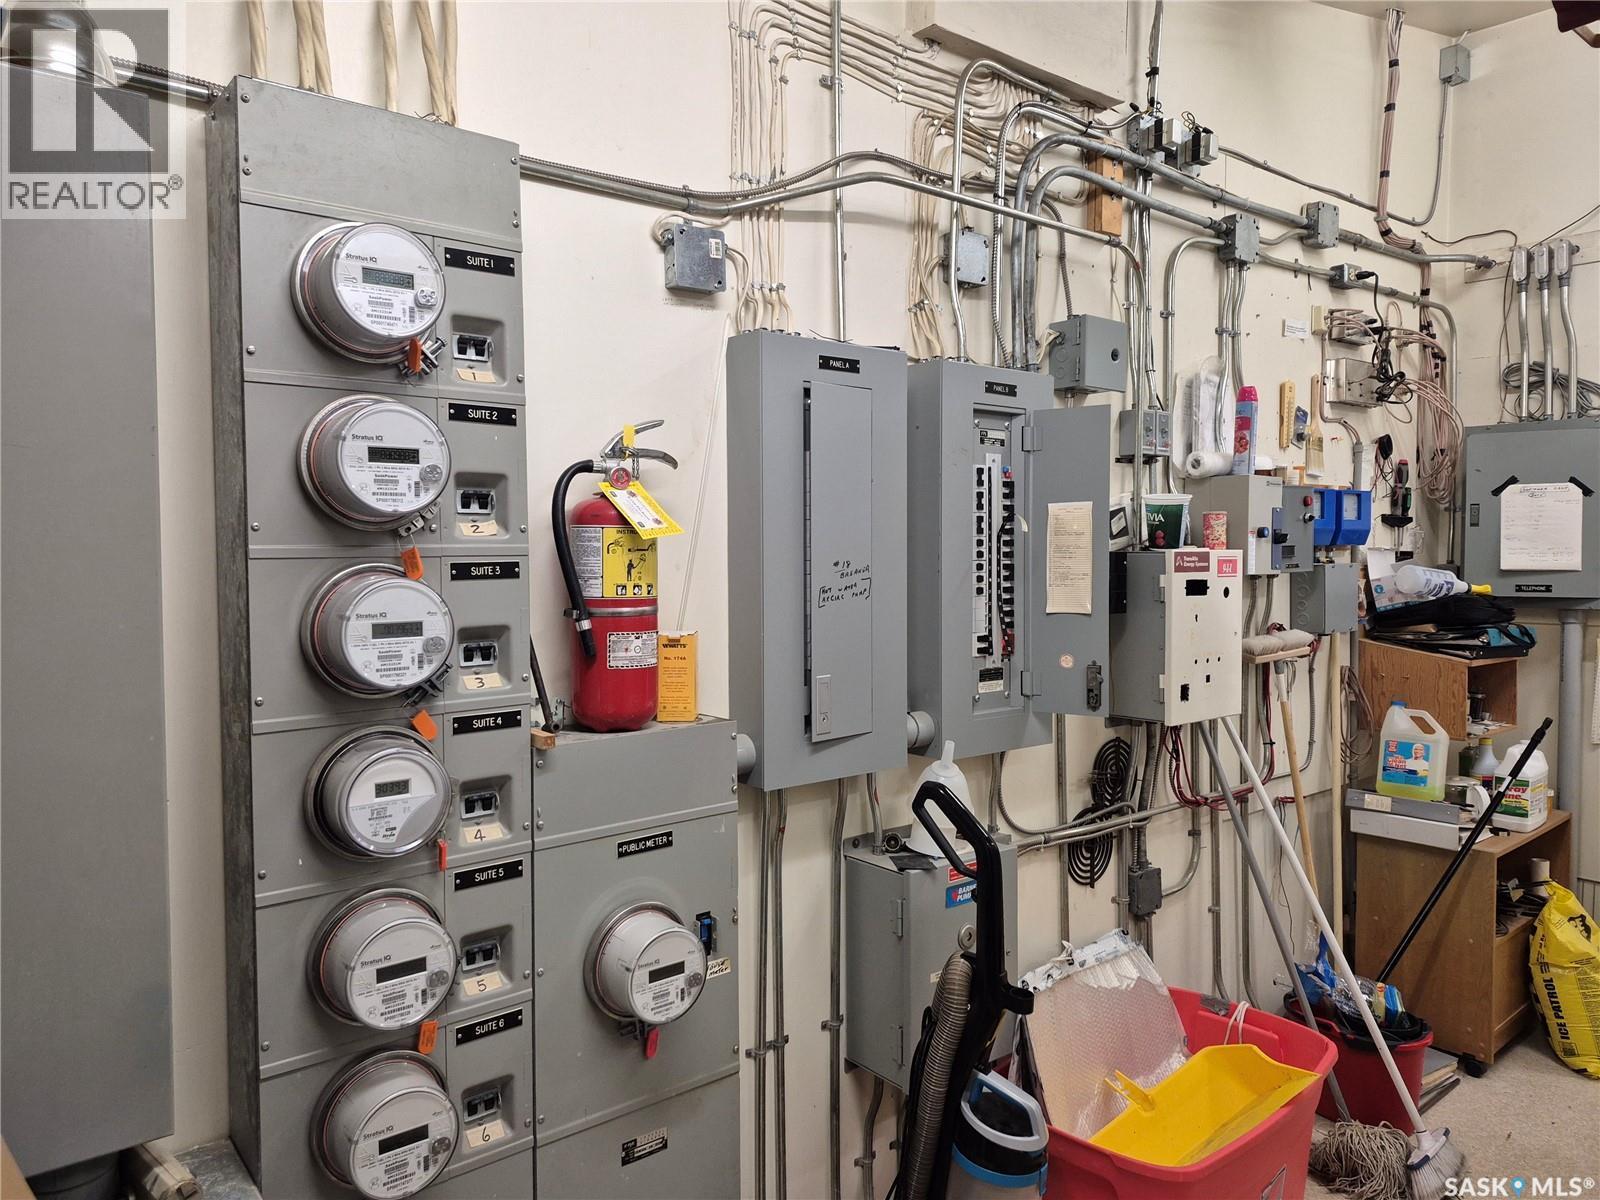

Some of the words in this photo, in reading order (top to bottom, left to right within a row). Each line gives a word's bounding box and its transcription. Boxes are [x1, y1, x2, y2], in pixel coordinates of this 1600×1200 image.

[346, 253, 368, 262] Stratus
[466, 256, 490, 267] SUITE
[829, 360, 845, 368] PANEL
[993, 384, 1005, 392] PANEL
[468, 409, 491, 420] SUITE
[492, 411, 498, 420] 2
[351, 433, 374, 441] Stratus
[470, 524, 484, 534] 2
[471, 566, 493, 575] SUITE
[494, 566, 501, 575] 3
[474, 677, 485, 688] 3
[472, 718, 495, 728] SUITE
[496, 717, 502, 725] 4
[473, 829, 486, 841] 4
[622, 841, 646, 853] PUBLIC
[646, 836, 668, 848] METER
[475, 871, 497, 882] SUITE
[498, 869, 505, 877] 5
[360, 958, 382, 966] Stratus
[476, 980, 487, 992] 5
[1543, 977, 1564, 1020] PATROL
[475, 1023, 497, 1035] SUITE
[498, 1019, 505, 1028] 6
[1557, 1022, 1570, 1040] ICE
[363, 1129, 385, 1138] Stratus
[482, 1127, 491, 1142] 6
